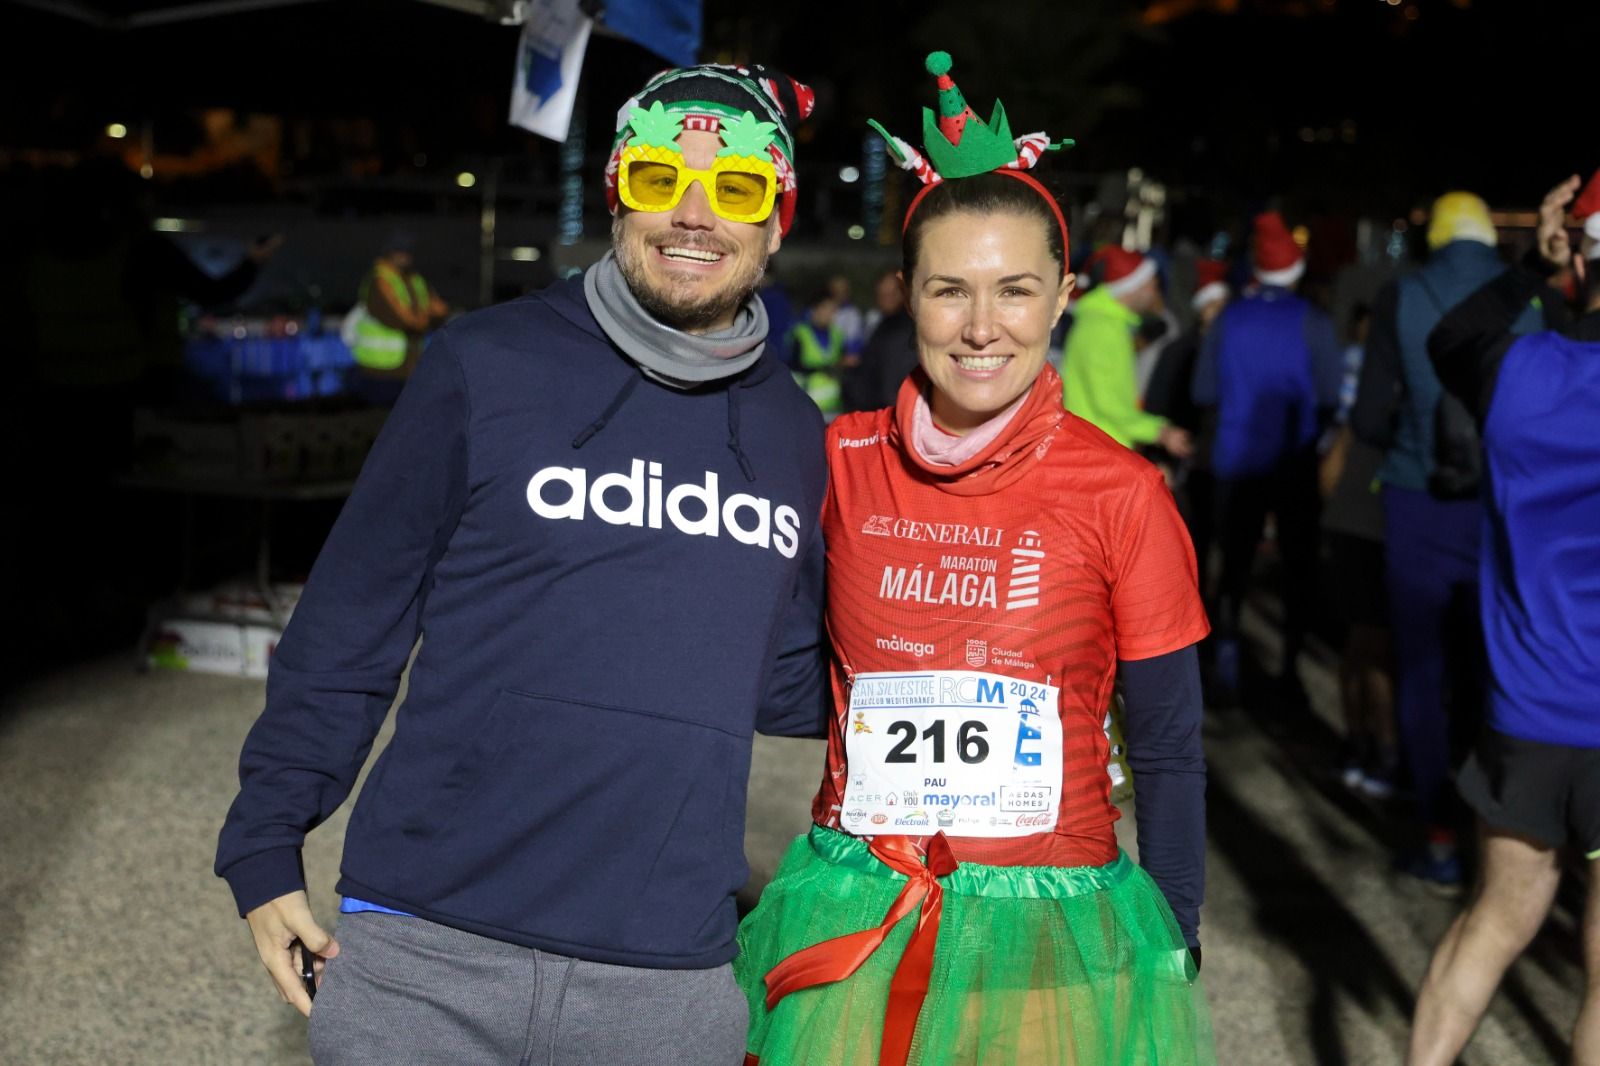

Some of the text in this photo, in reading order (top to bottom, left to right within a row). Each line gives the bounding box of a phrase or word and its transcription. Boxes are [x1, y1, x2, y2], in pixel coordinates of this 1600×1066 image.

[526, 458, 800, 559] adidas
[893, 518, 1004, 547] GENERALI
[940, 555, 997, 573] MARATÓN
[879, 563, 997, 609] MÁLAGA
[991, 647, 1023, 658] Ciudad
[991, 657, 1035, 669] de Málaga
[853, 680, 935, 698] SAN SILVESTRE
[939, 676, 1005, 704] RCM
[885, 719, 990, 765] 216
[924, 778, 947, 787] PAU
[923, 791, 995, 809] mayoral
